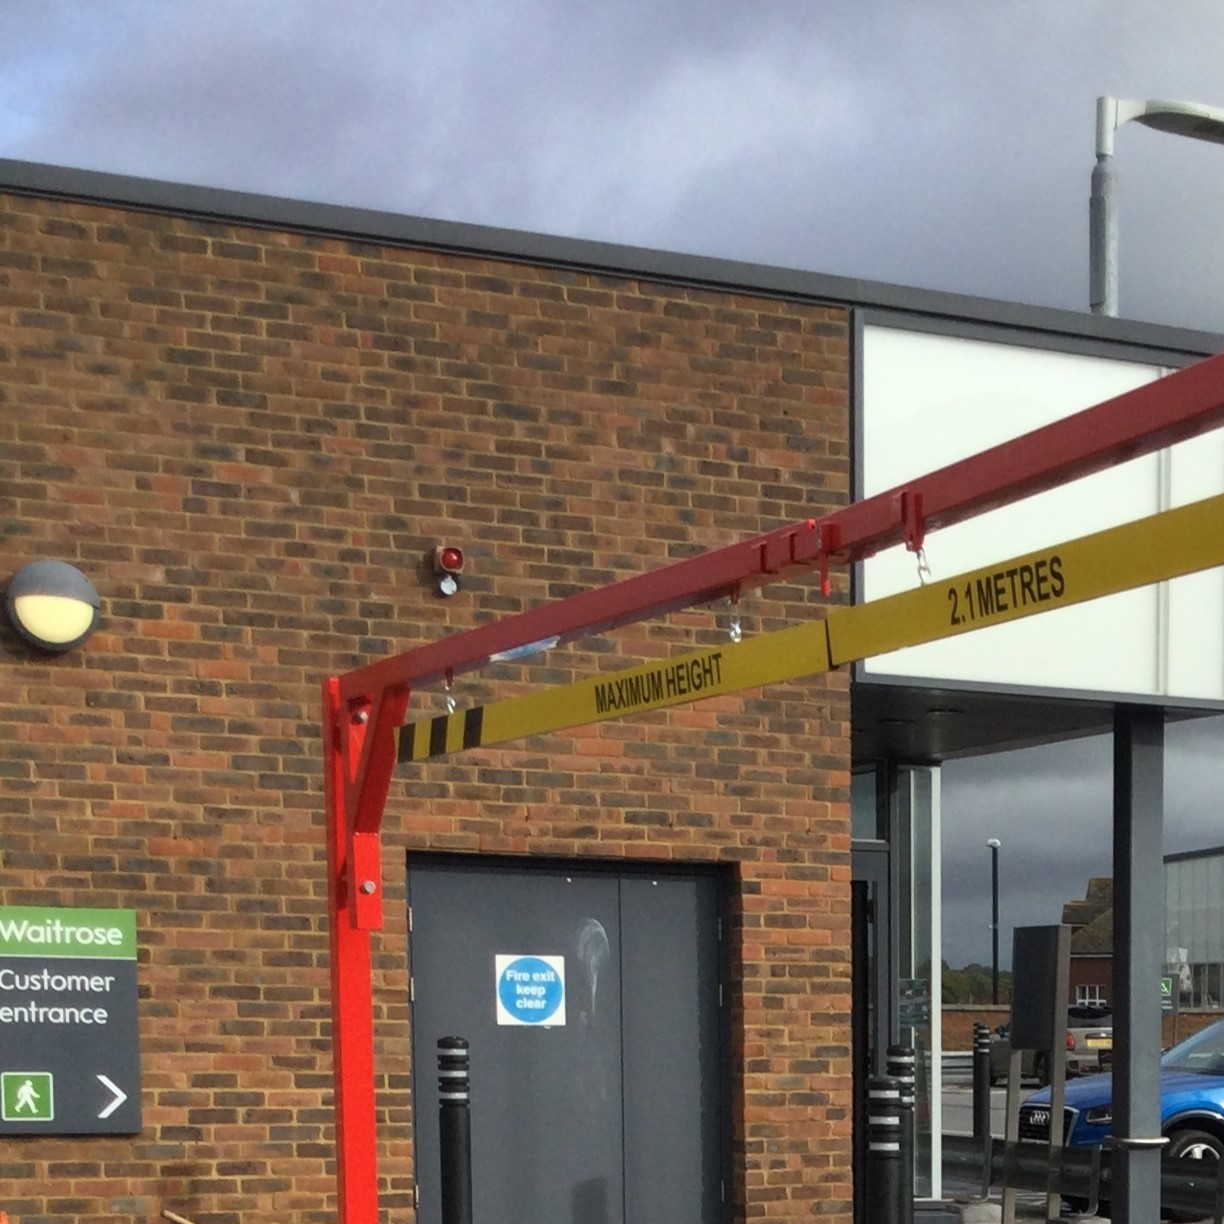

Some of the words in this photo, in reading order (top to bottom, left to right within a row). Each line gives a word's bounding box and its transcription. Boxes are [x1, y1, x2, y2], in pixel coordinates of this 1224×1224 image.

[948, 582, 975, 626] 2.1
[976, 555, 1065, 617] METRES
[595, 670, 664, 714] MAXIMUM
[665, 651, 722, 698] HEIGHT
[0, 918, 122, 946] Waitrose
[0, 968, 115, 992] Customer
[506, 970, 530, 982] Fire
[532, 971, 556, 982] exit
[516, 984, 546, 997] keep
[0, 1001, 108, 1024] entrance
[515, 997, 547, 1009] clear
